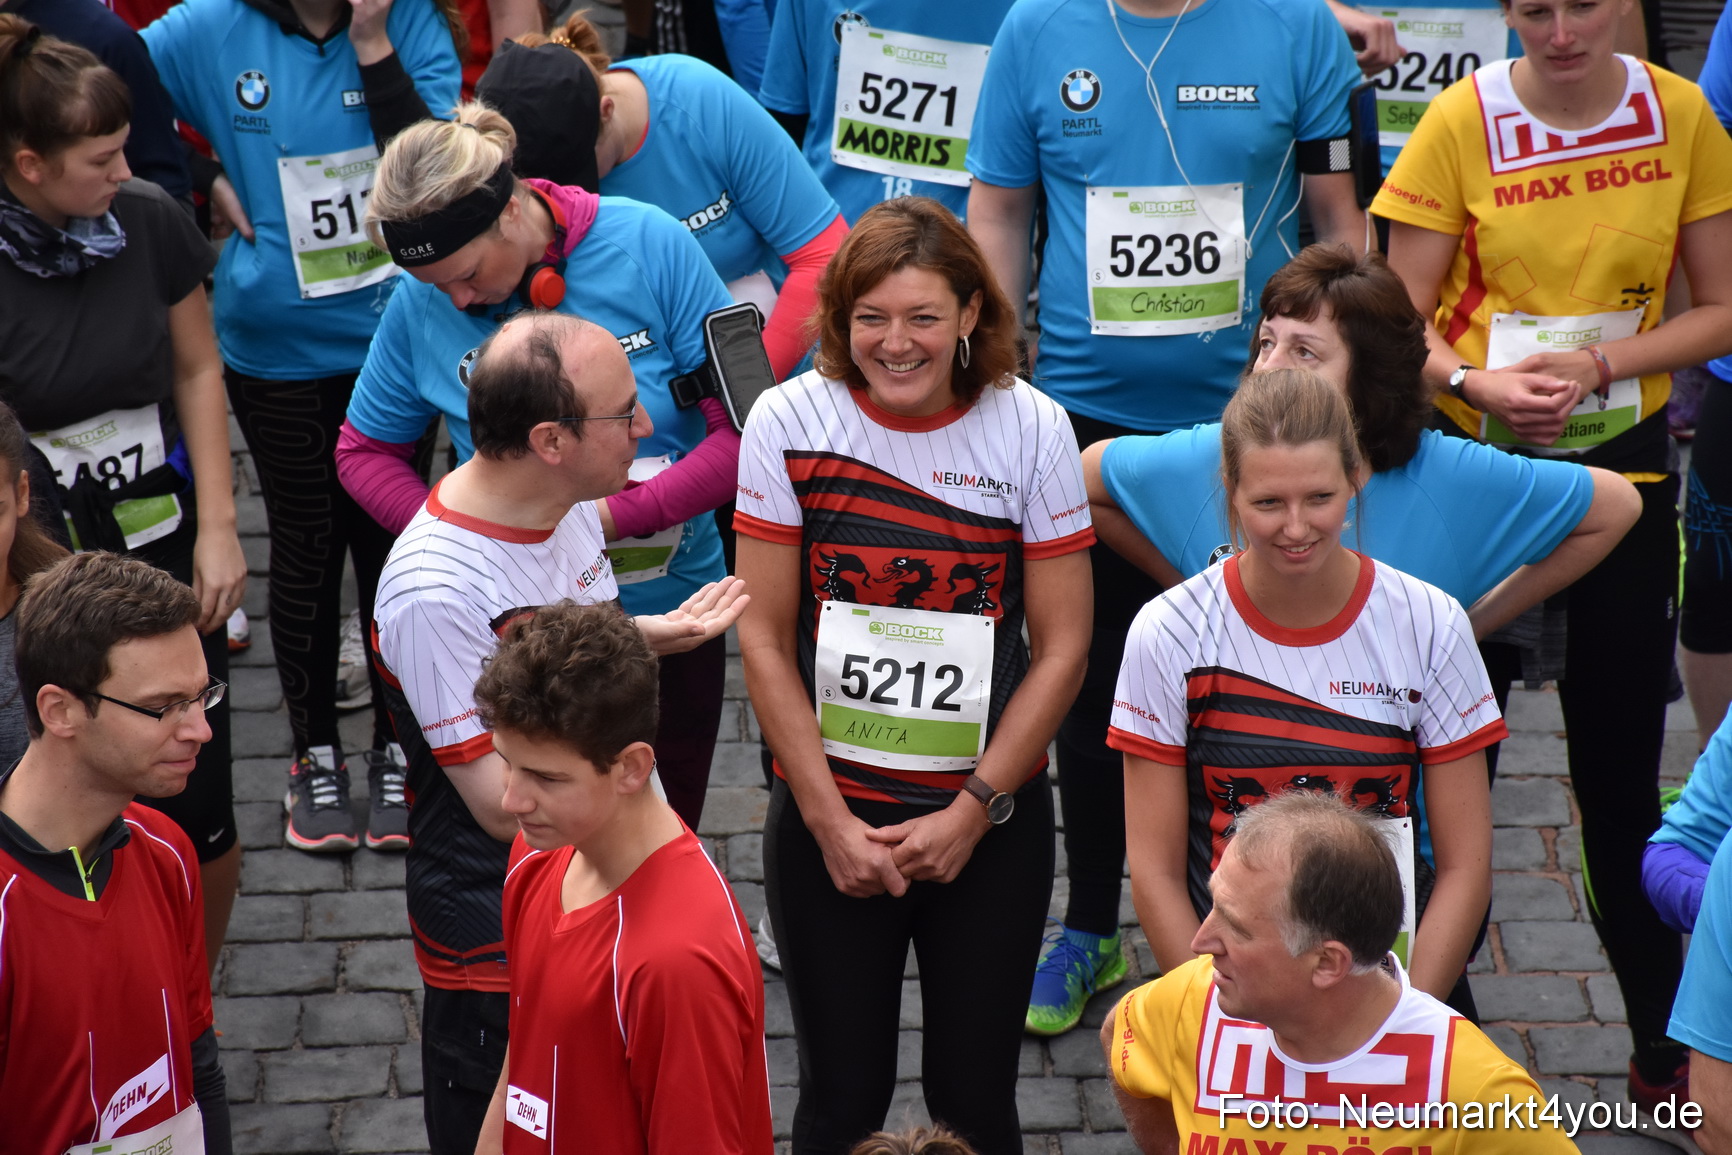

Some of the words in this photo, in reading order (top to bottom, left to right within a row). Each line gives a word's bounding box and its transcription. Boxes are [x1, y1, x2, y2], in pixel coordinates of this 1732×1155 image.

[896, 47, 947, 65] BOCK
[1064, 71, 1098, 86] BMW
[859, 72, 958, 127] 5271
[1177, 85, 1259, 103] BOCK
[233, 115, 271, 128] PARTL
[1062, 118, 1103, 129] PARTL
[1063, 128, 1102, 138] Neumarkt
[839, 123, 951, 167] MORRIS
[882, 176, 912, 200] 18
[1494, 174, 1574, 208] MAX
[1585, 158, 1672, 192] BÖGL
[311, 188, 372, 240] 51
[1144, 200, 1196, 214] BOCK
[400, 242, 434, 257] GORE
[1110, 230, 1221, 278] 5236
[1131, 291, 1205, 314] Christian
[1553, 327, 1602, 344] BOCK
[633, 346, 659, 360] concepts
[66, 420, 117, 446] BOCK
[53, 443, 143, 492] 487
[932, 471, 1012, 495] NEUMARKT
[886, 623, 944, 641] BOCK
[840, 653, 964, 712] 5212
[844, 720, 908, 745] ANITA
[112, 1081, 148, 1122] DEHN
[517, 1101, 538, 1123] DEHN
